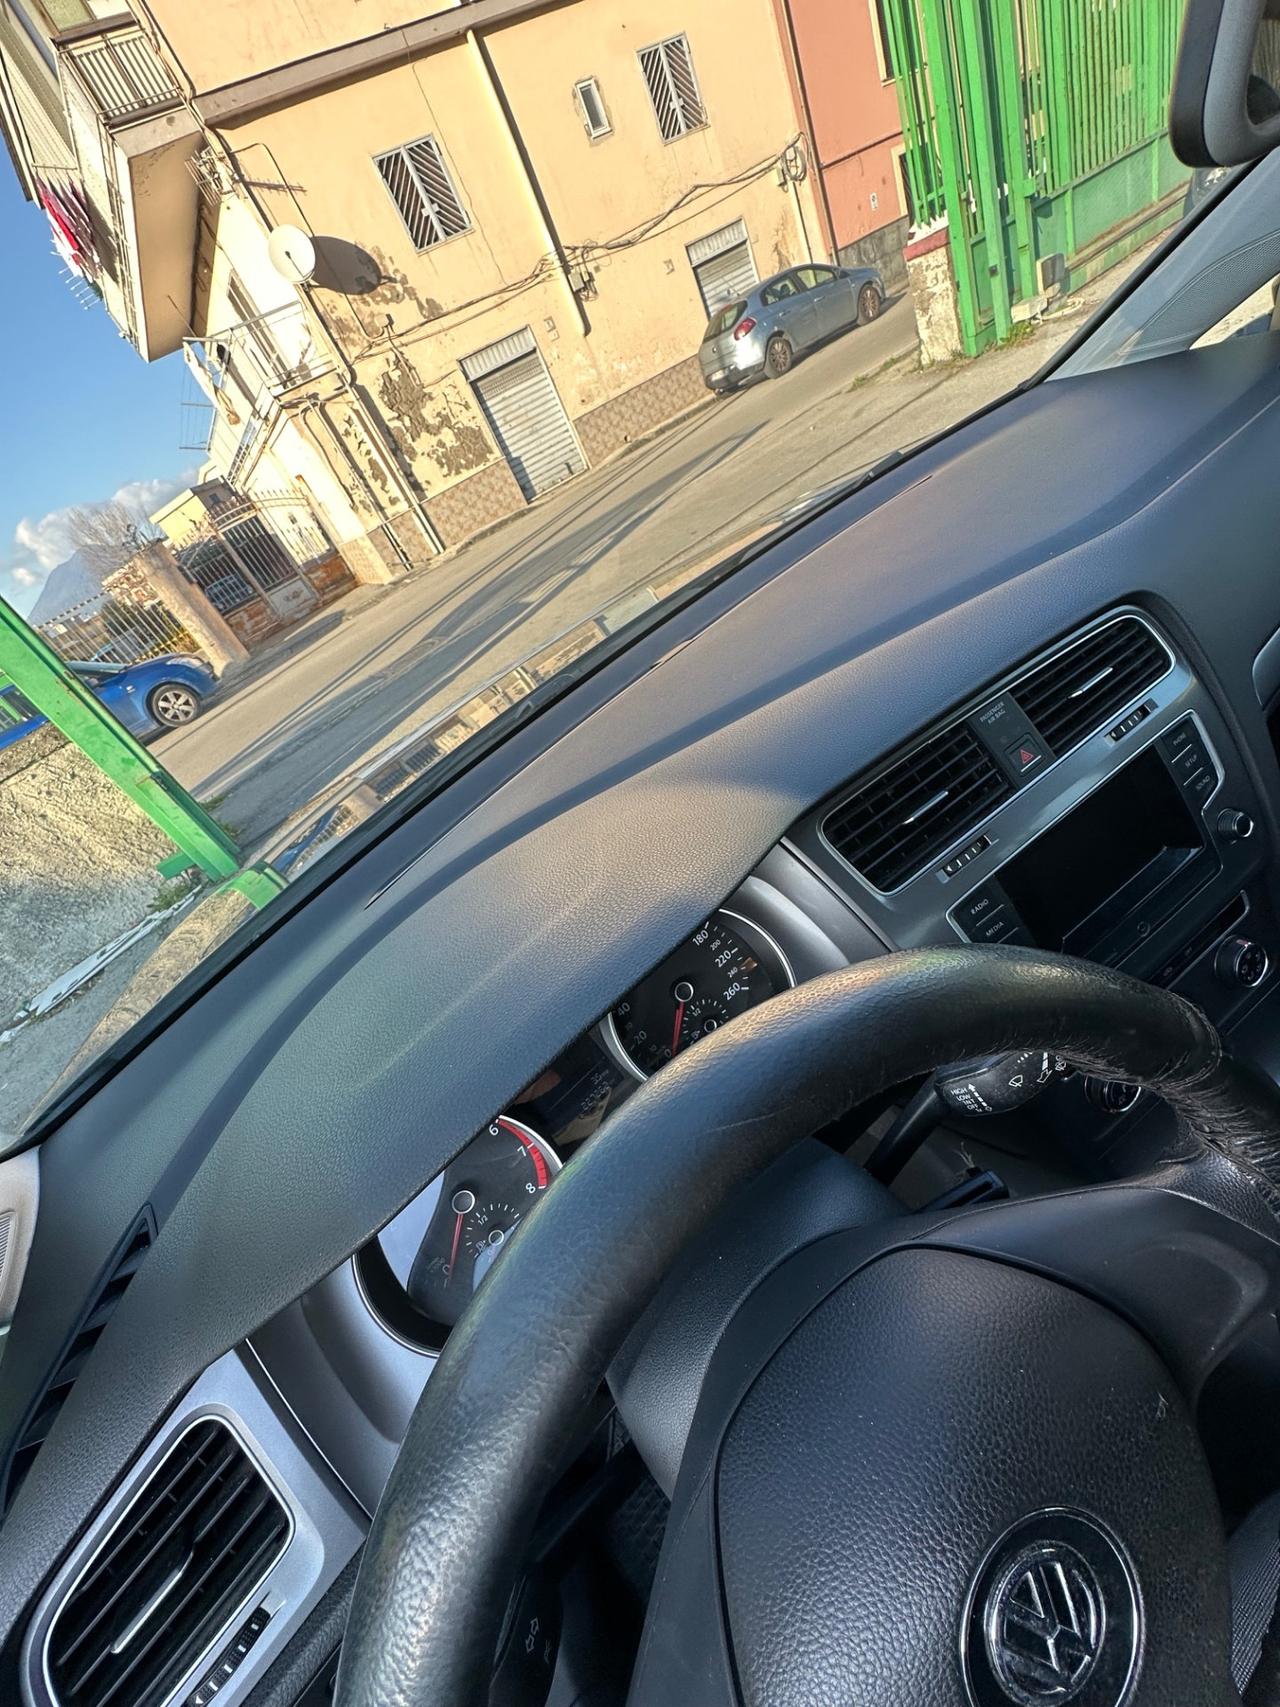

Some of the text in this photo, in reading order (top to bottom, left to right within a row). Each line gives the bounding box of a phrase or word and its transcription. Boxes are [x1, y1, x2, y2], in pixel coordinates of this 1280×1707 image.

[970, 898, 989, 915] RADIO
[985, 921, 1005, 936] MEDIA
[692, 929, 709, 947] 180
[709, 939, 722, 951] 200
[714, 950, 732, 968] 220
[727, 966, 739, 978] 240
[723, 982, 742, 1001] 260
[616, 1002, 631, 1017] 40
[633, 1030, 648, 1045] 20
[950, 1087, 968, 1096] HIGH
[956, 1093, 971, 1102] LOW
[488, 1124, 499, 1136] 6
[516, 1145, 527, 1157] 7
[525, 1182, 536, 1194] 8
[477, 1214, 489, 1226] 1/2
